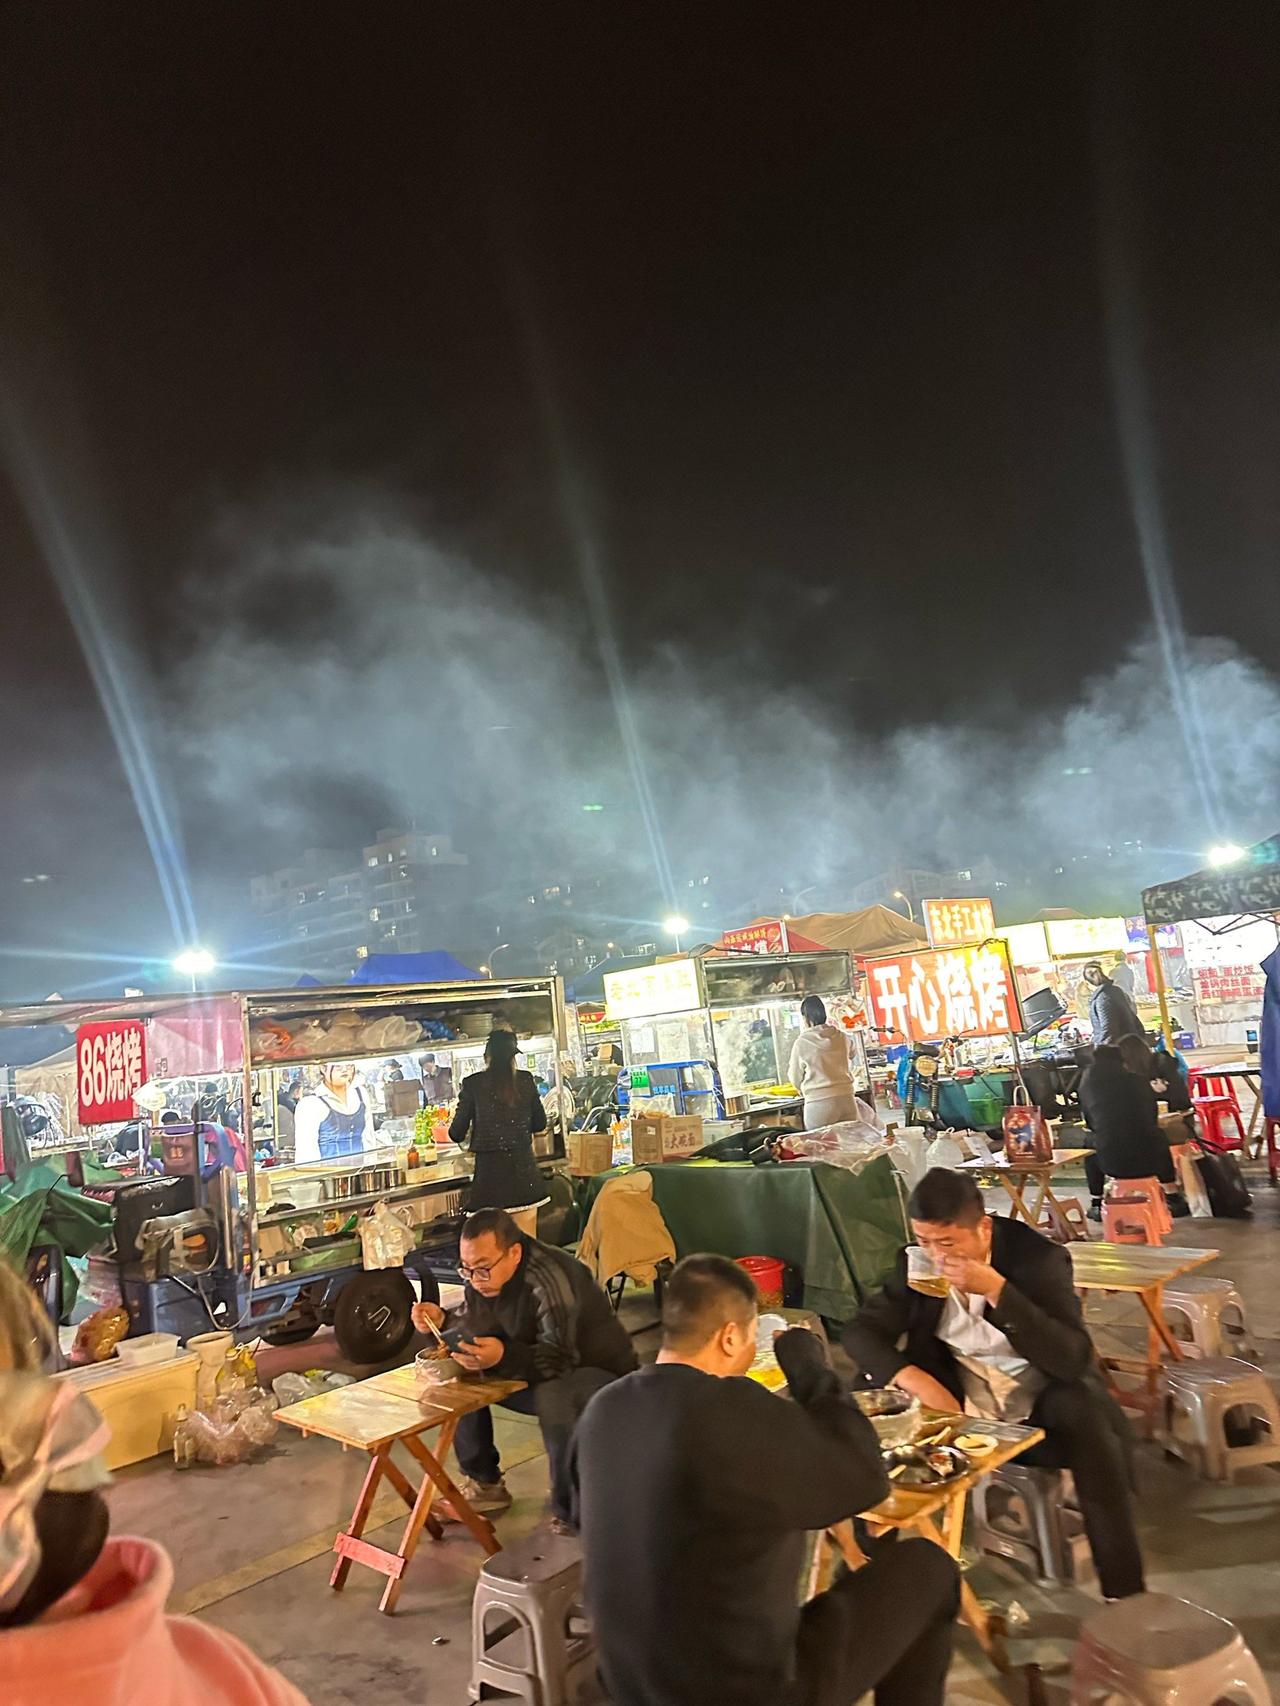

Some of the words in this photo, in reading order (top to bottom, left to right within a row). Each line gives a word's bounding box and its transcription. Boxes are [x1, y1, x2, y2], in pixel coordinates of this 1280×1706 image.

[873, 948, 1008, 1041] 开心烧烤
[80, 1027, 142, 1107] 86烧烤
